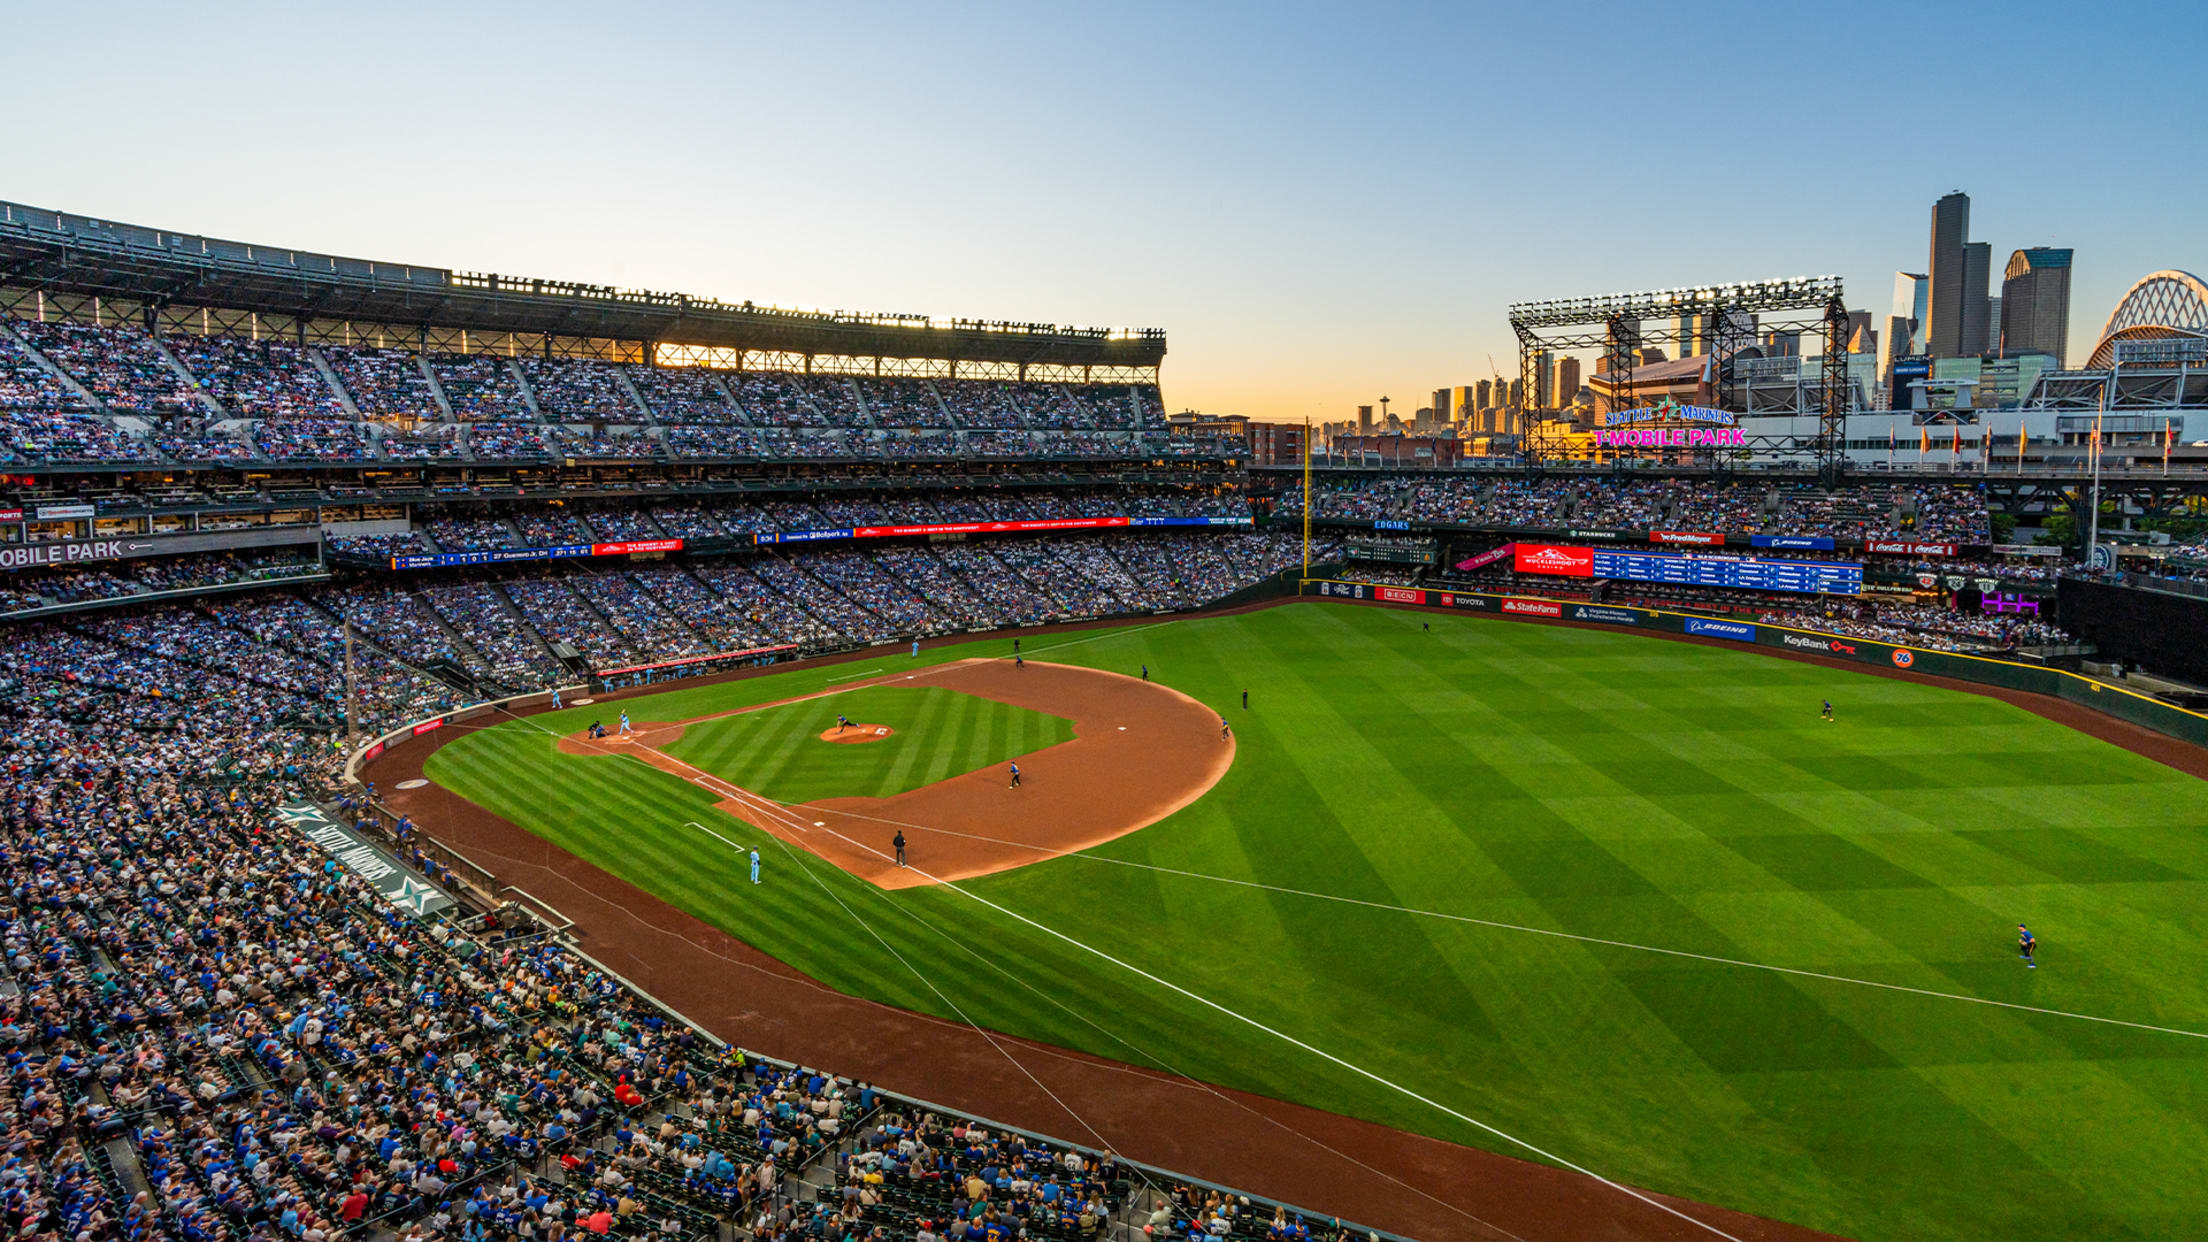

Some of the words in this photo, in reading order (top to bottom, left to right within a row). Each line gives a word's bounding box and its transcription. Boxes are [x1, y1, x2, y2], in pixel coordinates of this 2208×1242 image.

[1606, 407, 1652, 426] SEATTLE
[1680, 405, 1734, 424] MARINERS
[1594, 428, 1682, 446] T-MOBILE
[1690, 428, 1746, 446] PARK
[66, 541, 122, 560] PARK
[1456, 598, 1484, 606] TOYOTA
[1704, 623, 1748, 634] BOEING
[1784, 635, 1829, 650] KeyBank
[1896, 653, 1910, 663] 76
